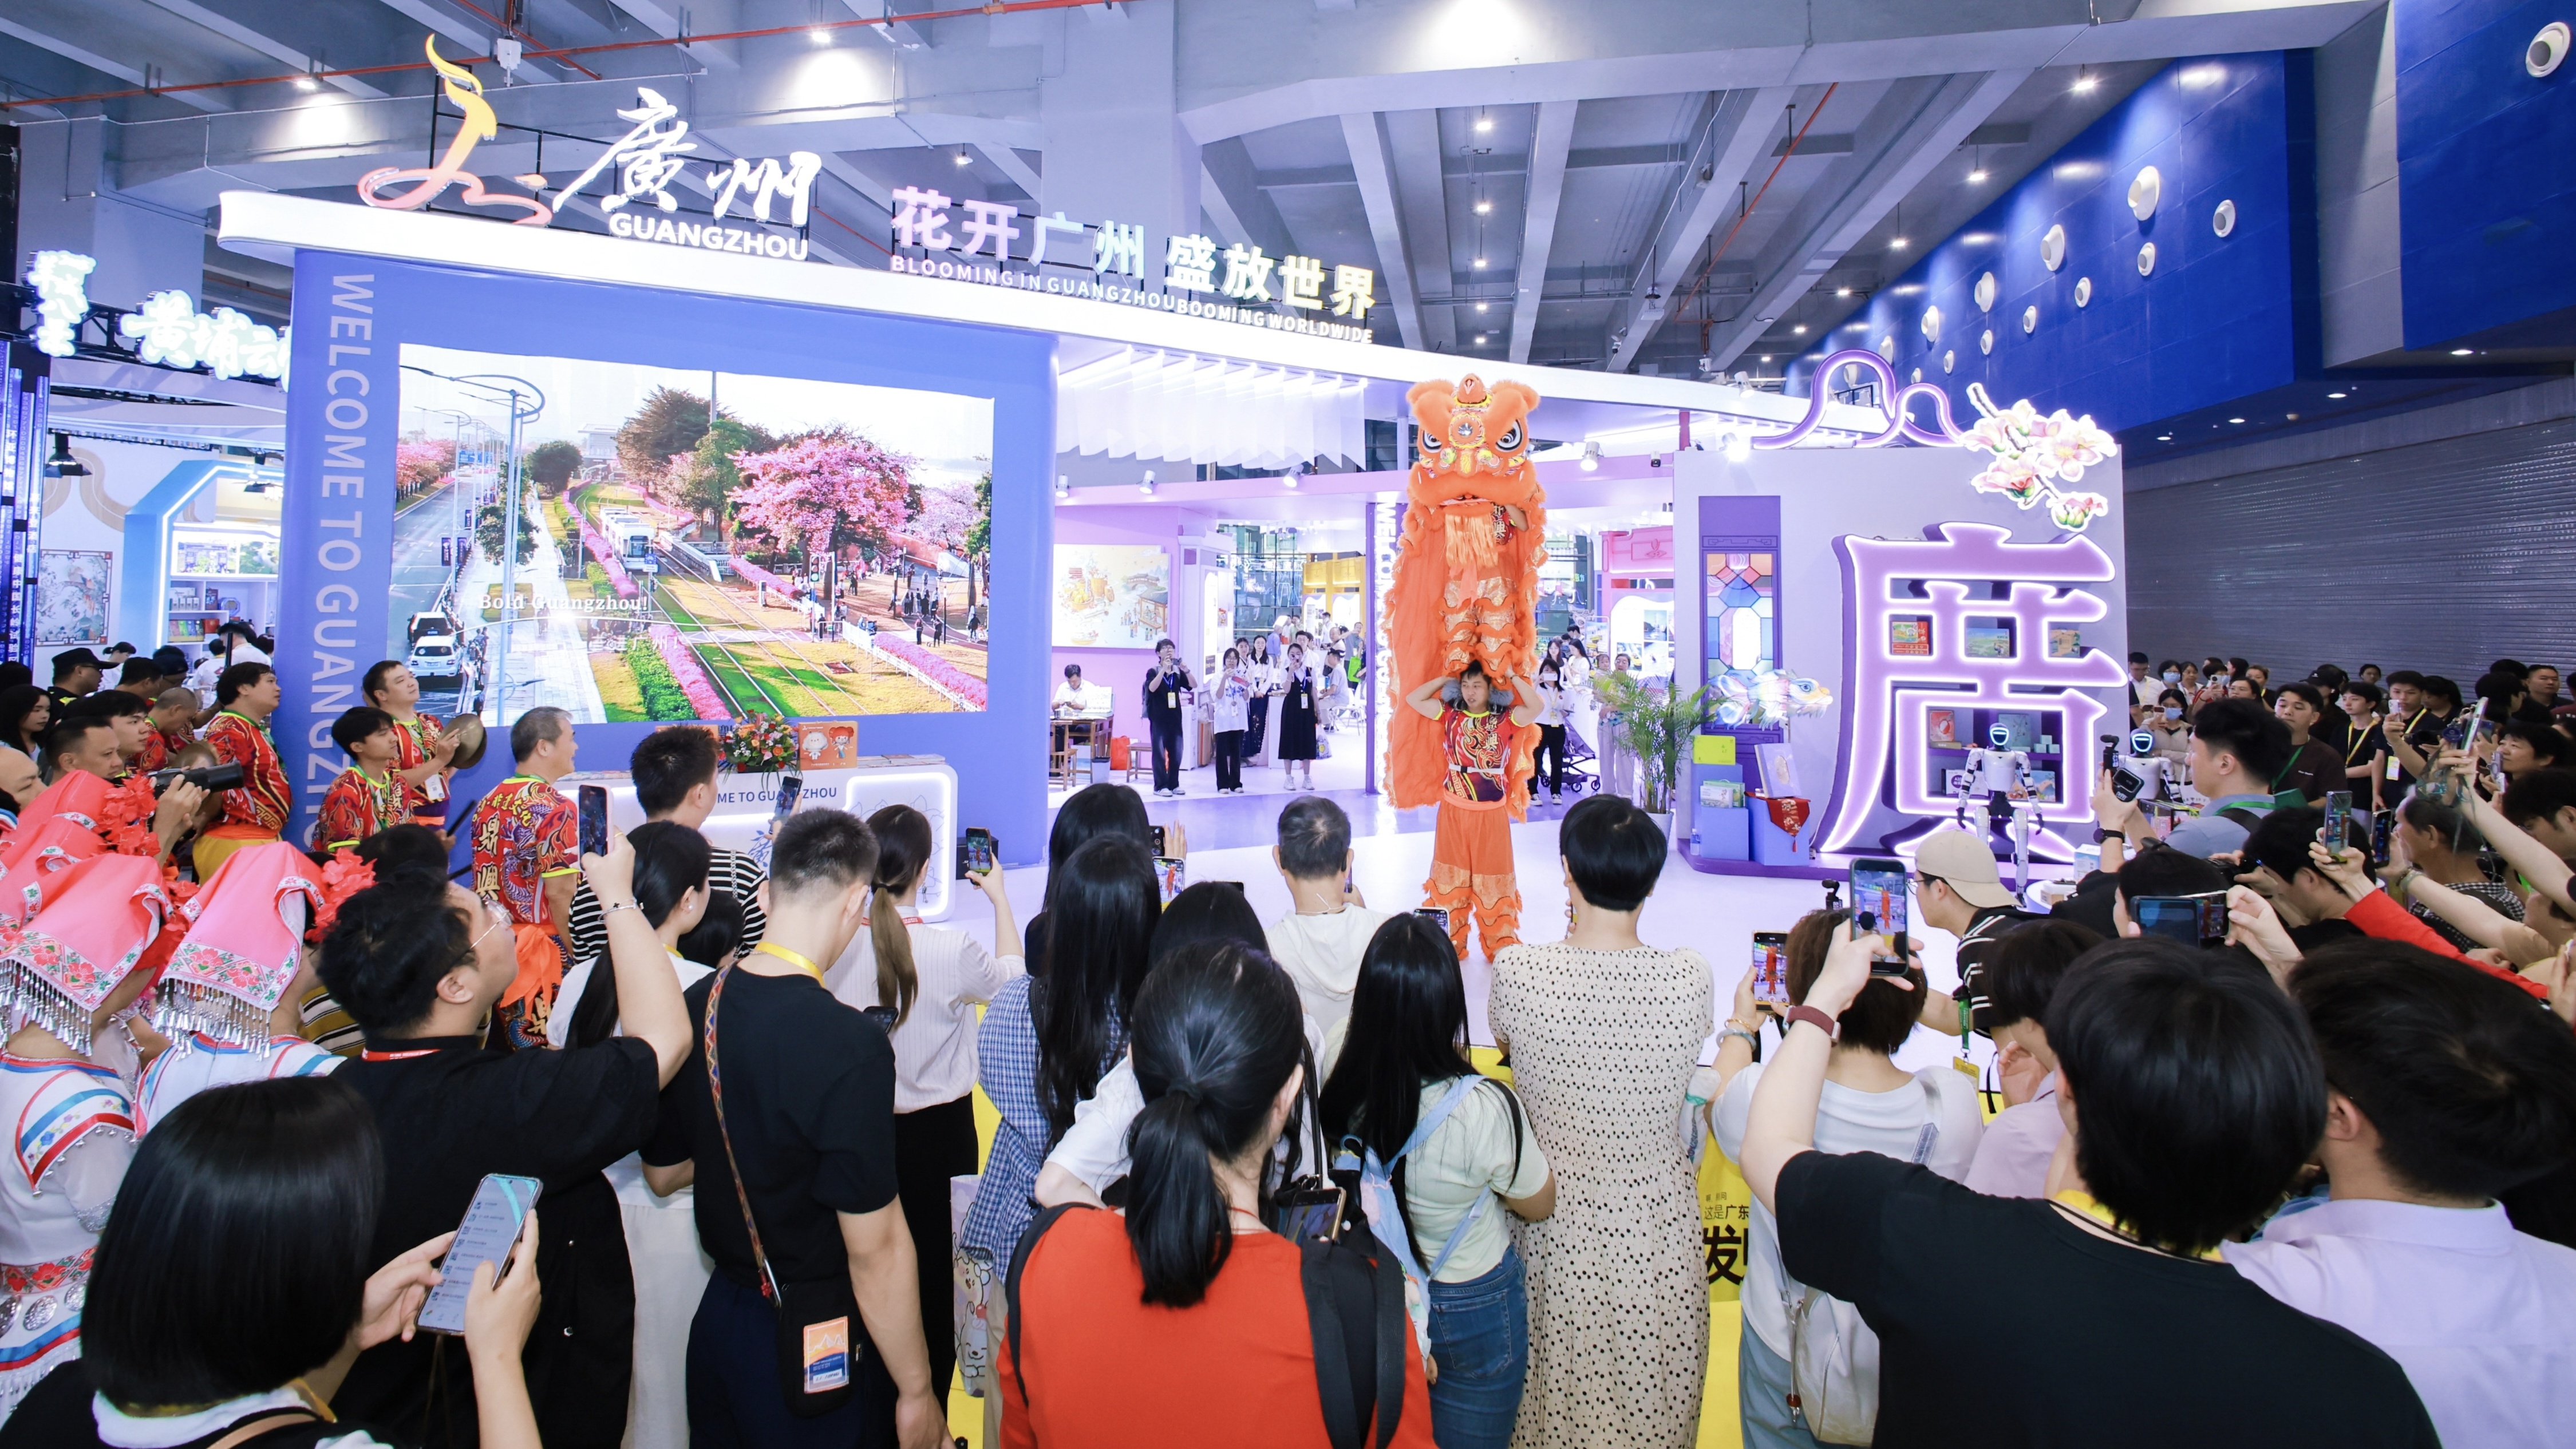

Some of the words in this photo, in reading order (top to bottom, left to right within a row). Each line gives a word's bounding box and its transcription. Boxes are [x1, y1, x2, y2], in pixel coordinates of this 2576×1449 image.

[609, 213, 808, 260] GUANGZHOU
[891, 186, 1145, 279] 花开广州
[1165, 233, 1376, 319] 盛放世界
[891, 255, 1013, 286] BLOOMING
[1019, 275, 1041, 290] IN
[1268, 313, 1373, 343] WORLDWIDE
[322, 274, 375, 498] WELCOME
[318, 511, 363, 571] TO
[478, 595, 524, 609] Bold
[532, 595, 648, 612] Guangzhou!
[305, 584, 359, 847] GUANGZ
[738, 792, 755, 802] TO
[758, 787, 837, 801] GUZHOU
[1704, 1205, 1749, 1220] 这是广东
